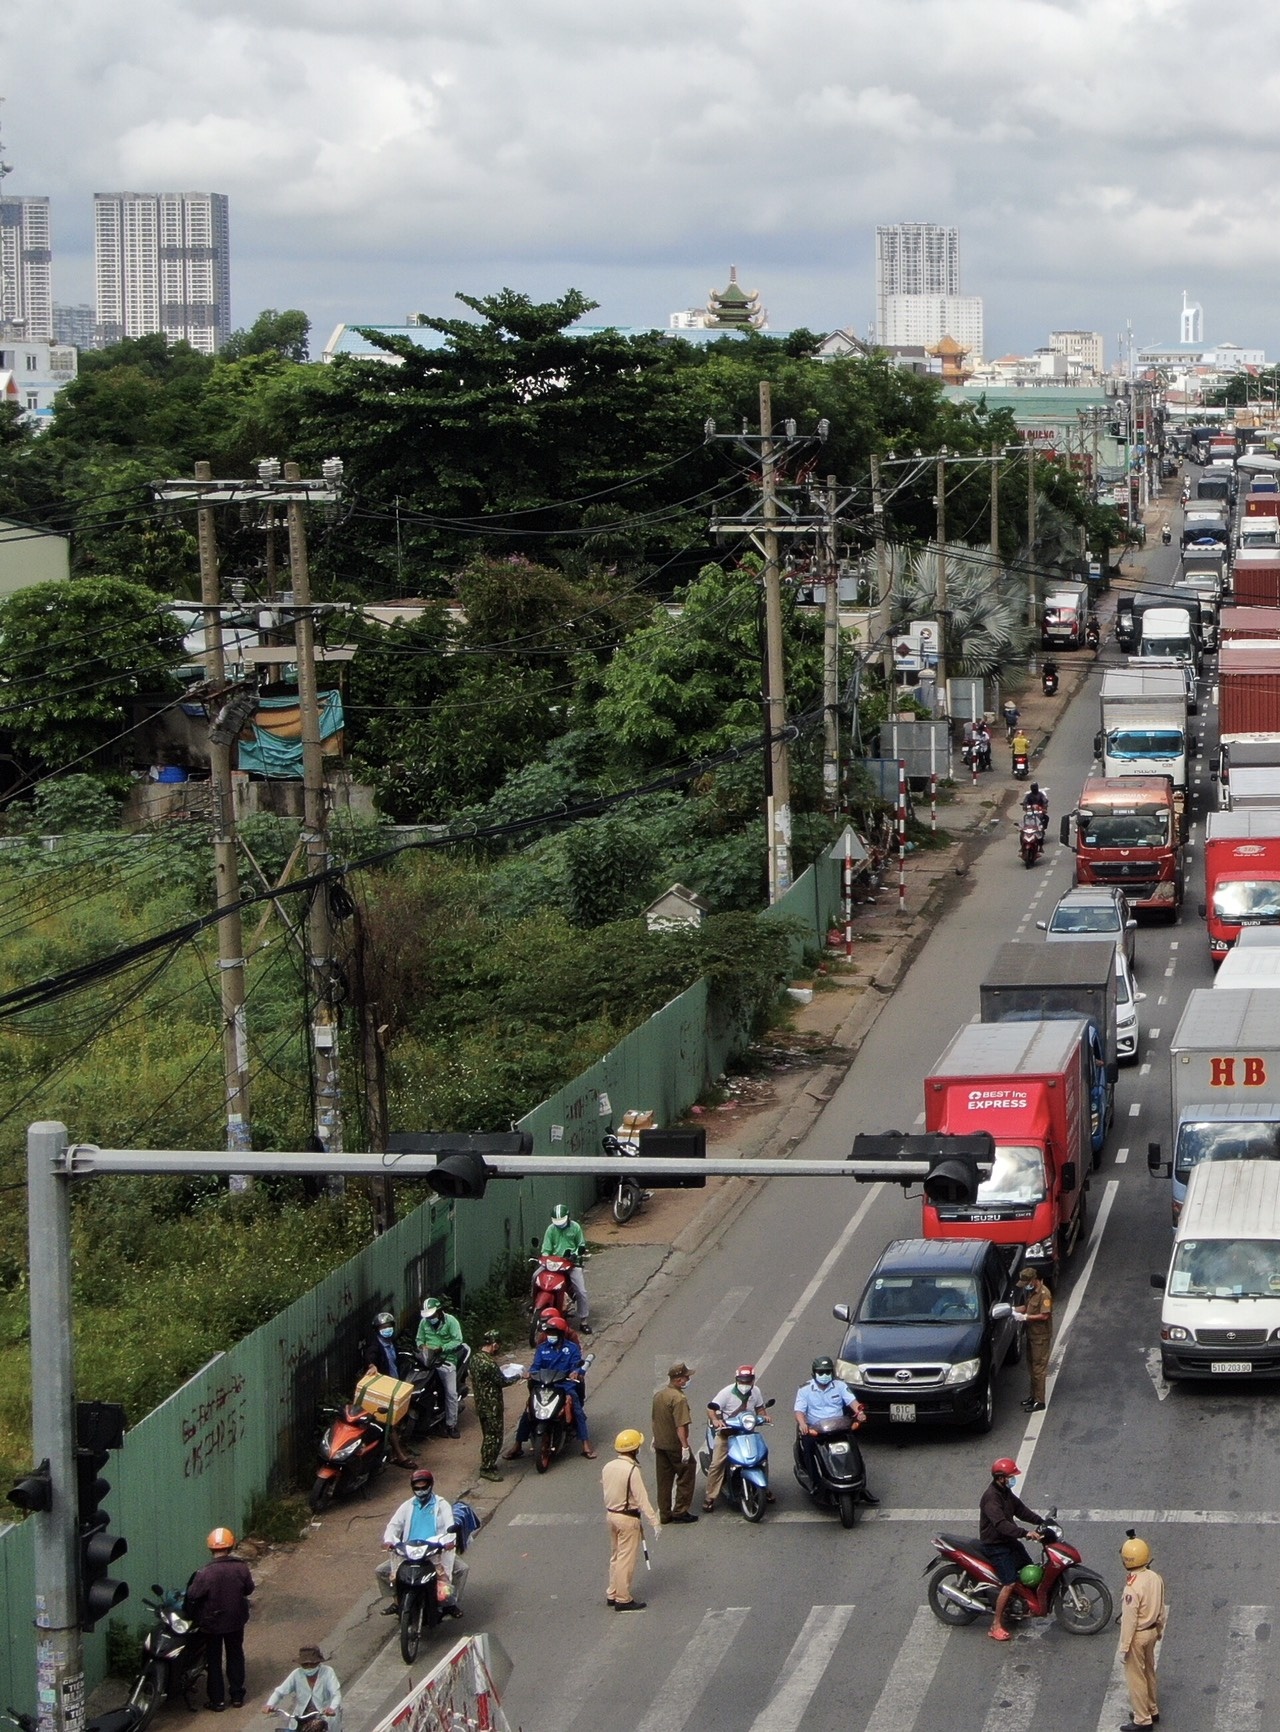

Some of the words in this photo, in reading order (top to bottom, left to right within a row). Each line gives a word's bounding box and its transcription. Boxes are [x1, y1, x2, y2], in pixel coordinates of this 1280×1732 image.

[982, 1090, 1011, 1098] BEST
[1012, 1090, 1027, 1098] Inc
[968, 1099, 1027, 1110] EXPRESS
[970, 1214, 1001, 1222] ISUZU
